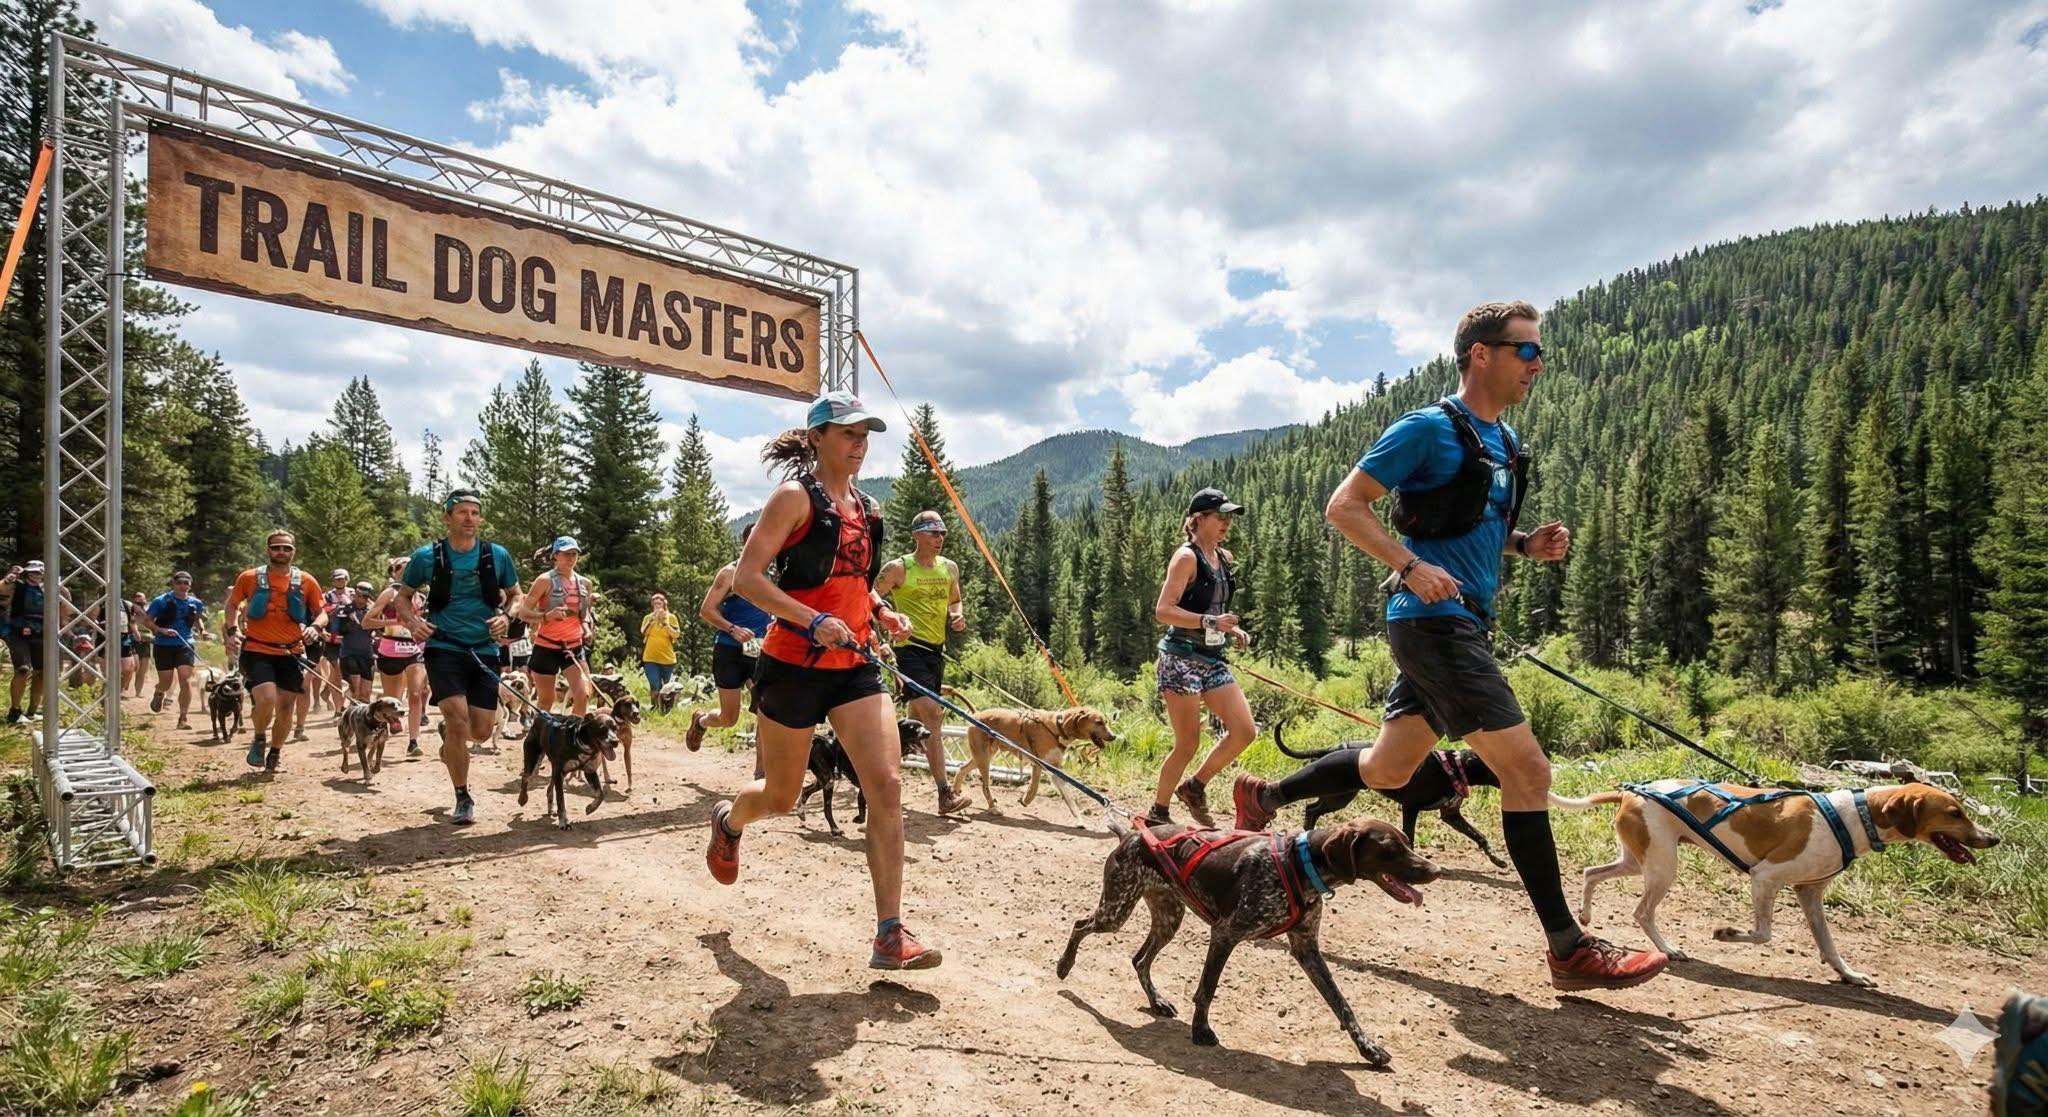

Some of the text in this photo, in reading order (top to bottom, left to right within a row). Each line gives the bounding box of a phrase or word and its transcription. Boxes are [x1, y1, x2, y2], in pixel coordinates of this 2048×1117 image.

[184, 173, 805, 374] TRAIL DOG MASTERS
